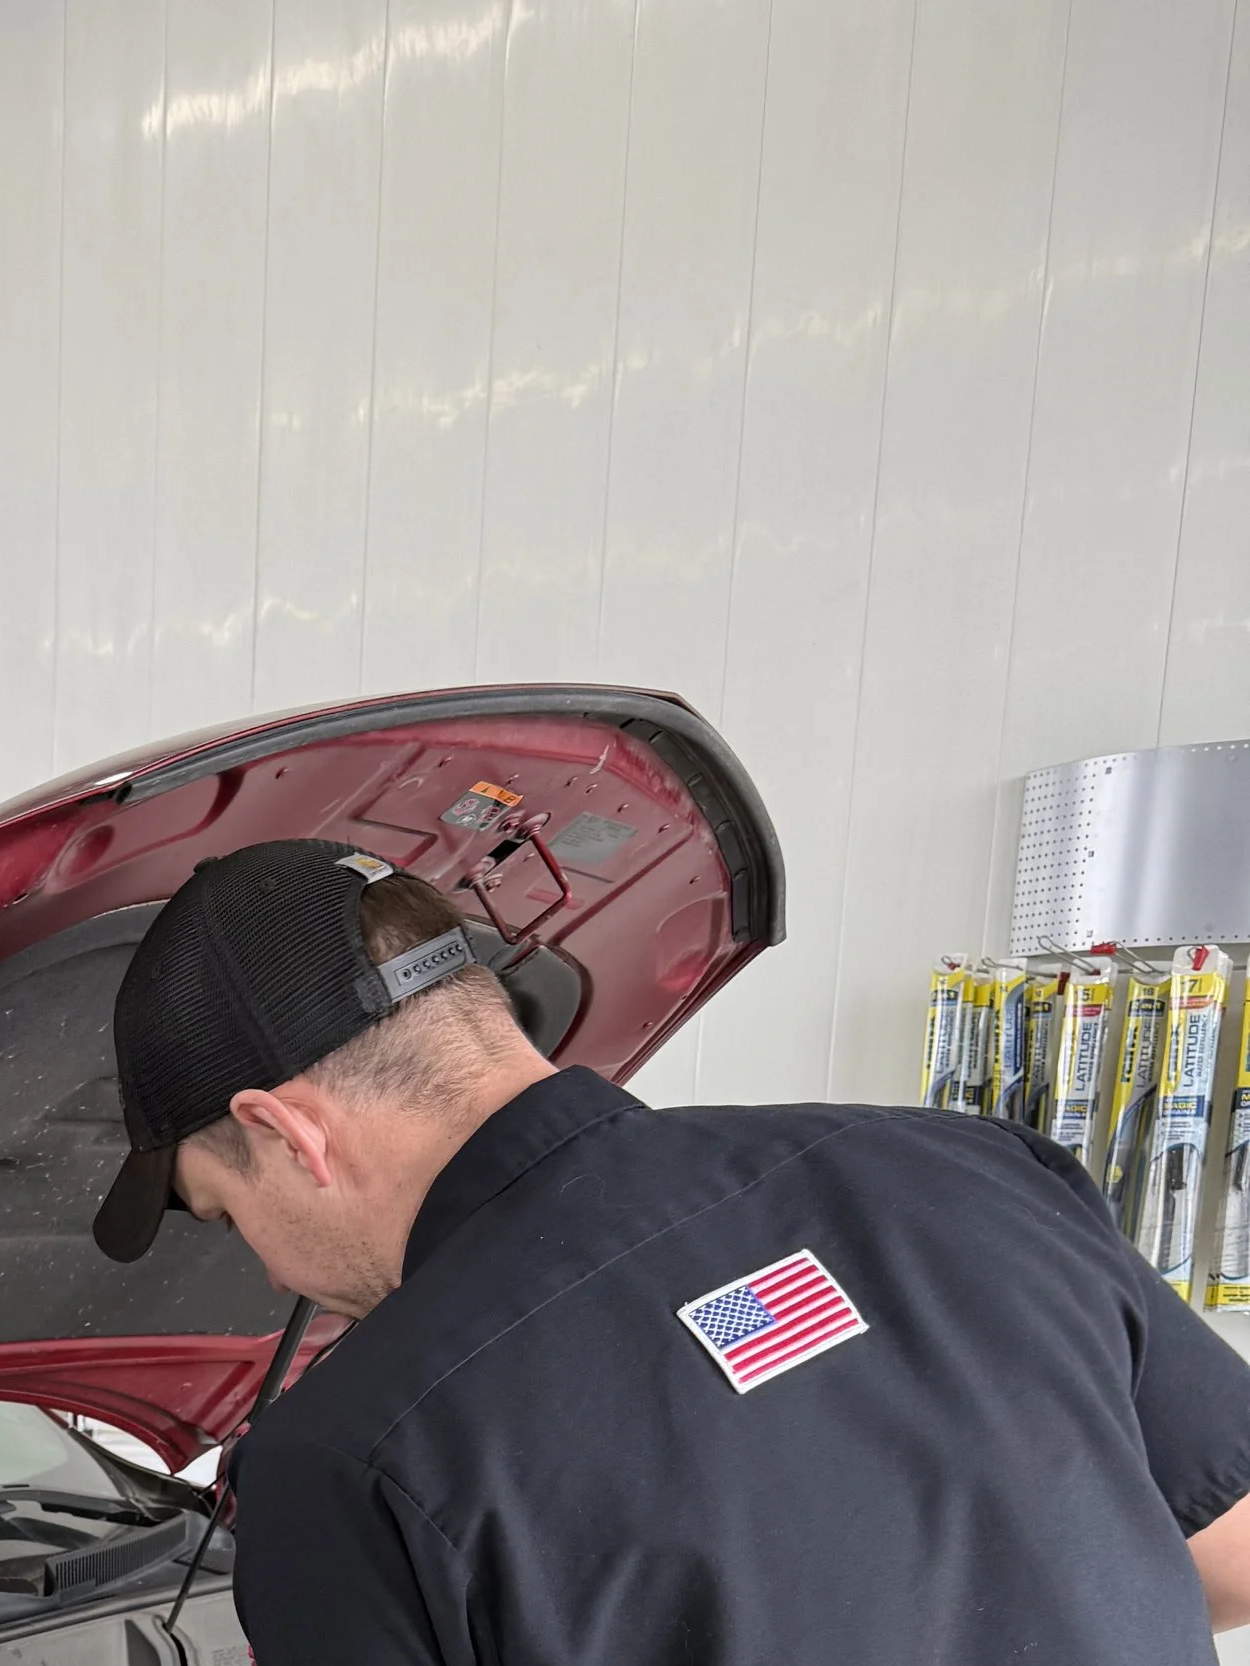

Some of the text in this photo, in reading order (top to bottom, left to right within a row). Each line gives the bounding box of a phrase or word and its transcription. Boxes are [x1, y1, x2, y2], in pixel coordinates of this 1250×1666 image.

[1075, 1022, 1092, 1091] LATITUDE
[1135, 1022, 1151, 1088] LATITUDE
[1183, 1014, 1200, 1087] LATITUDE
